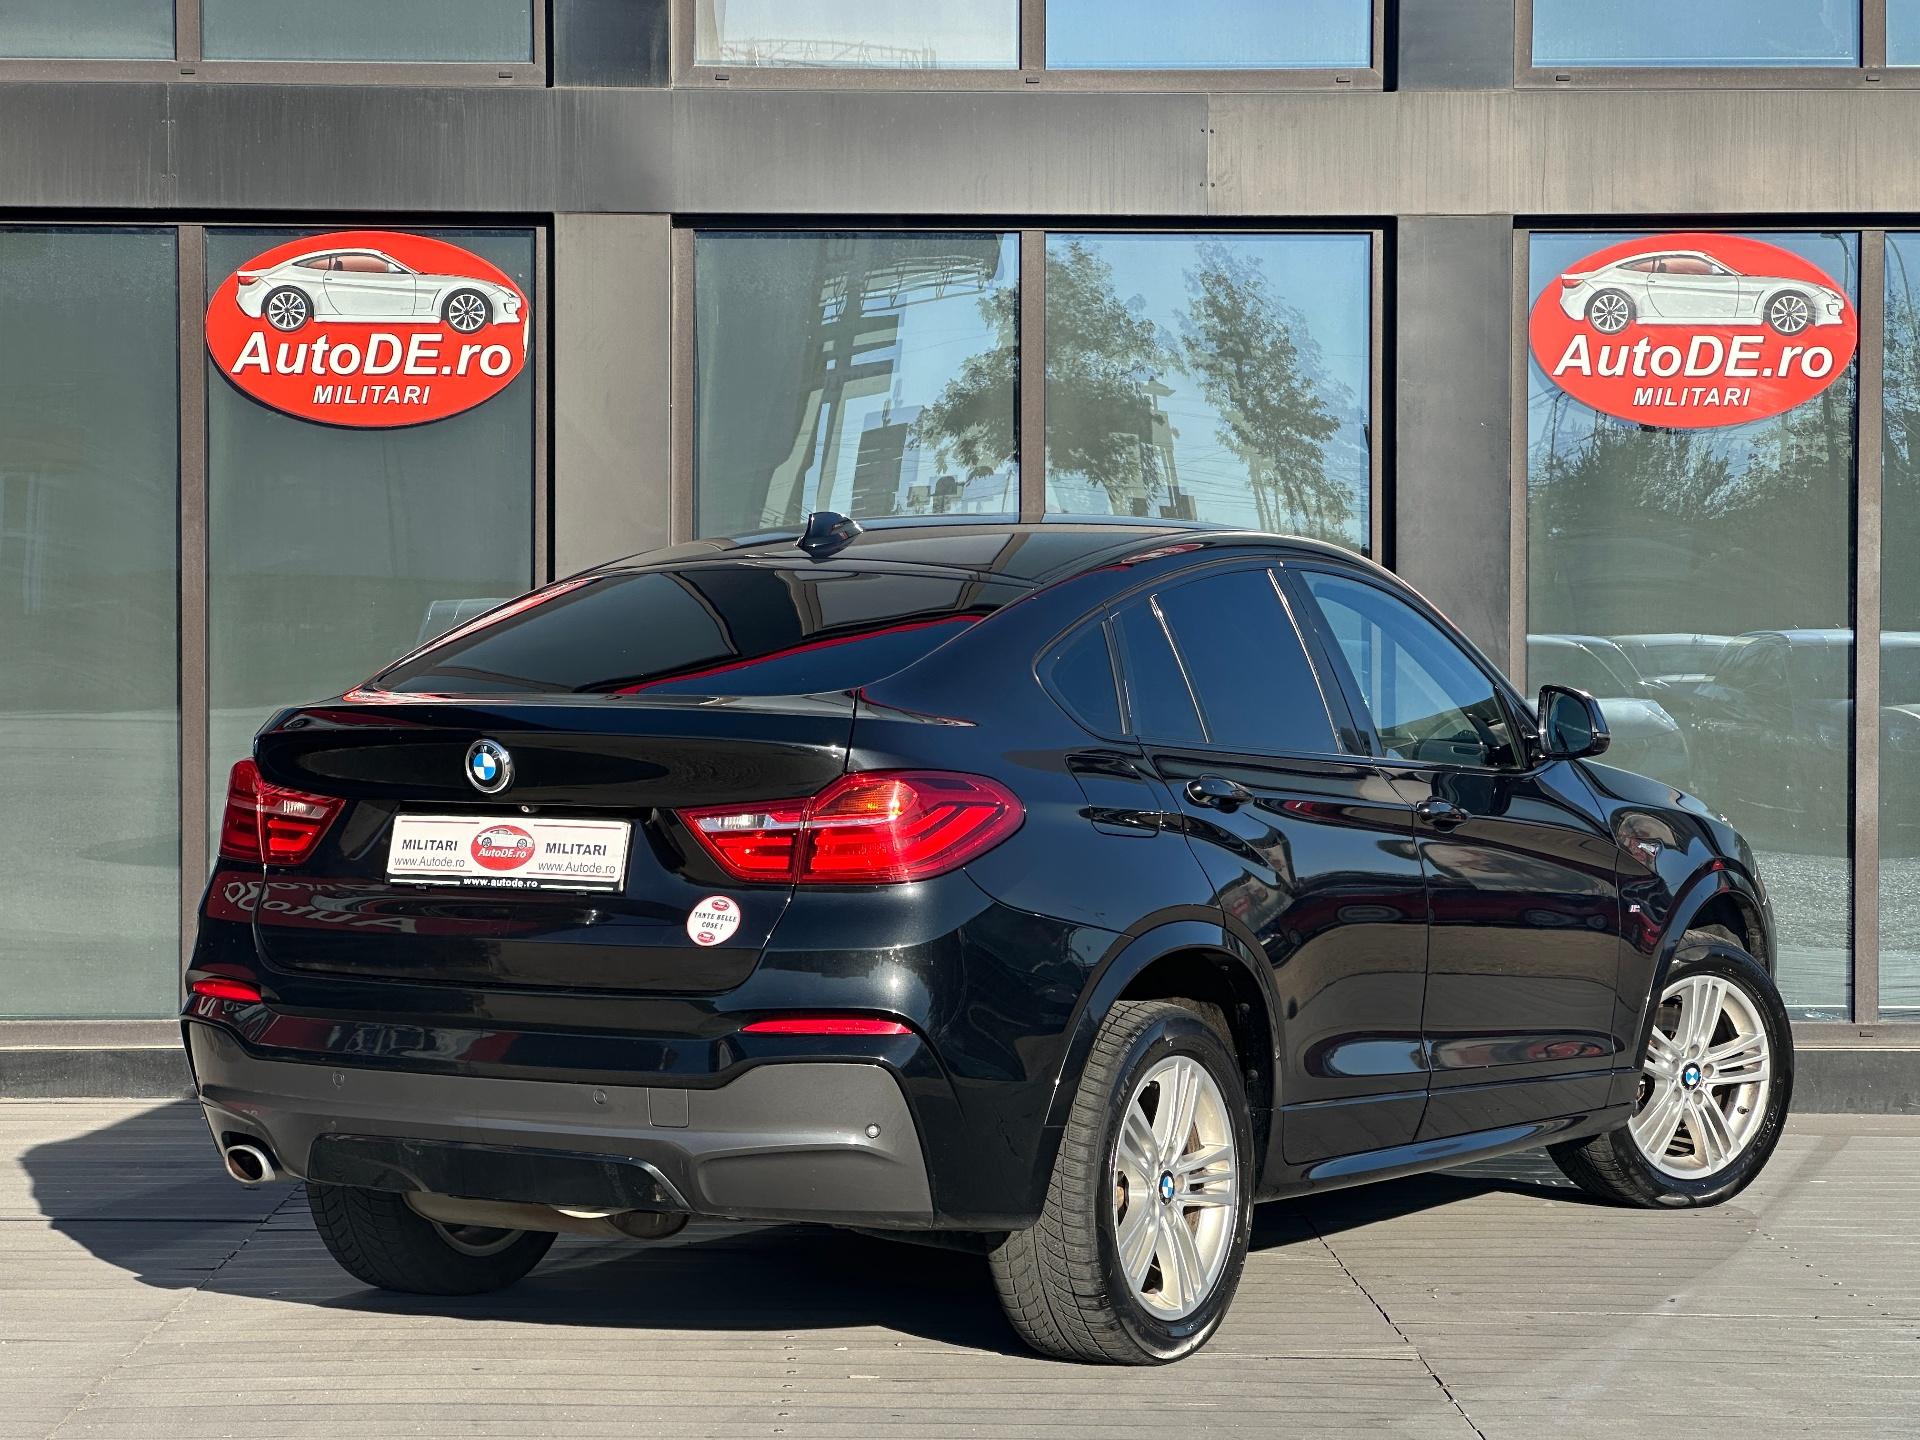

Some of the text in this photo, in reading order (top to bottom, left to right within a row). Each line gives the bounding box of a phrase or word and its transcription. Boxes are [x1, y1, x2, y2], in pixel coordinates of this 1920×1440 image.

[231, 332, 512, 376] AutoDE.ro
[1552, 334, 1834, 378] AutoDE.ro
[312, 385, 431, 405] MILITARI
[1633, 387, 1751, 407] MILITARI
[402, 839, 458, 851] MILITARI
[545, 842, 607, 856] MILITARI
[478, 848, 527, 858] AutoDE.ro
[394, 856, 465, 868] www.Autode.ro
[538, 861, 616, 874] www.Autode.ro
[463, 878, 538, 888] www.autode.ro
[694, 912, 715, 920] TANTE
